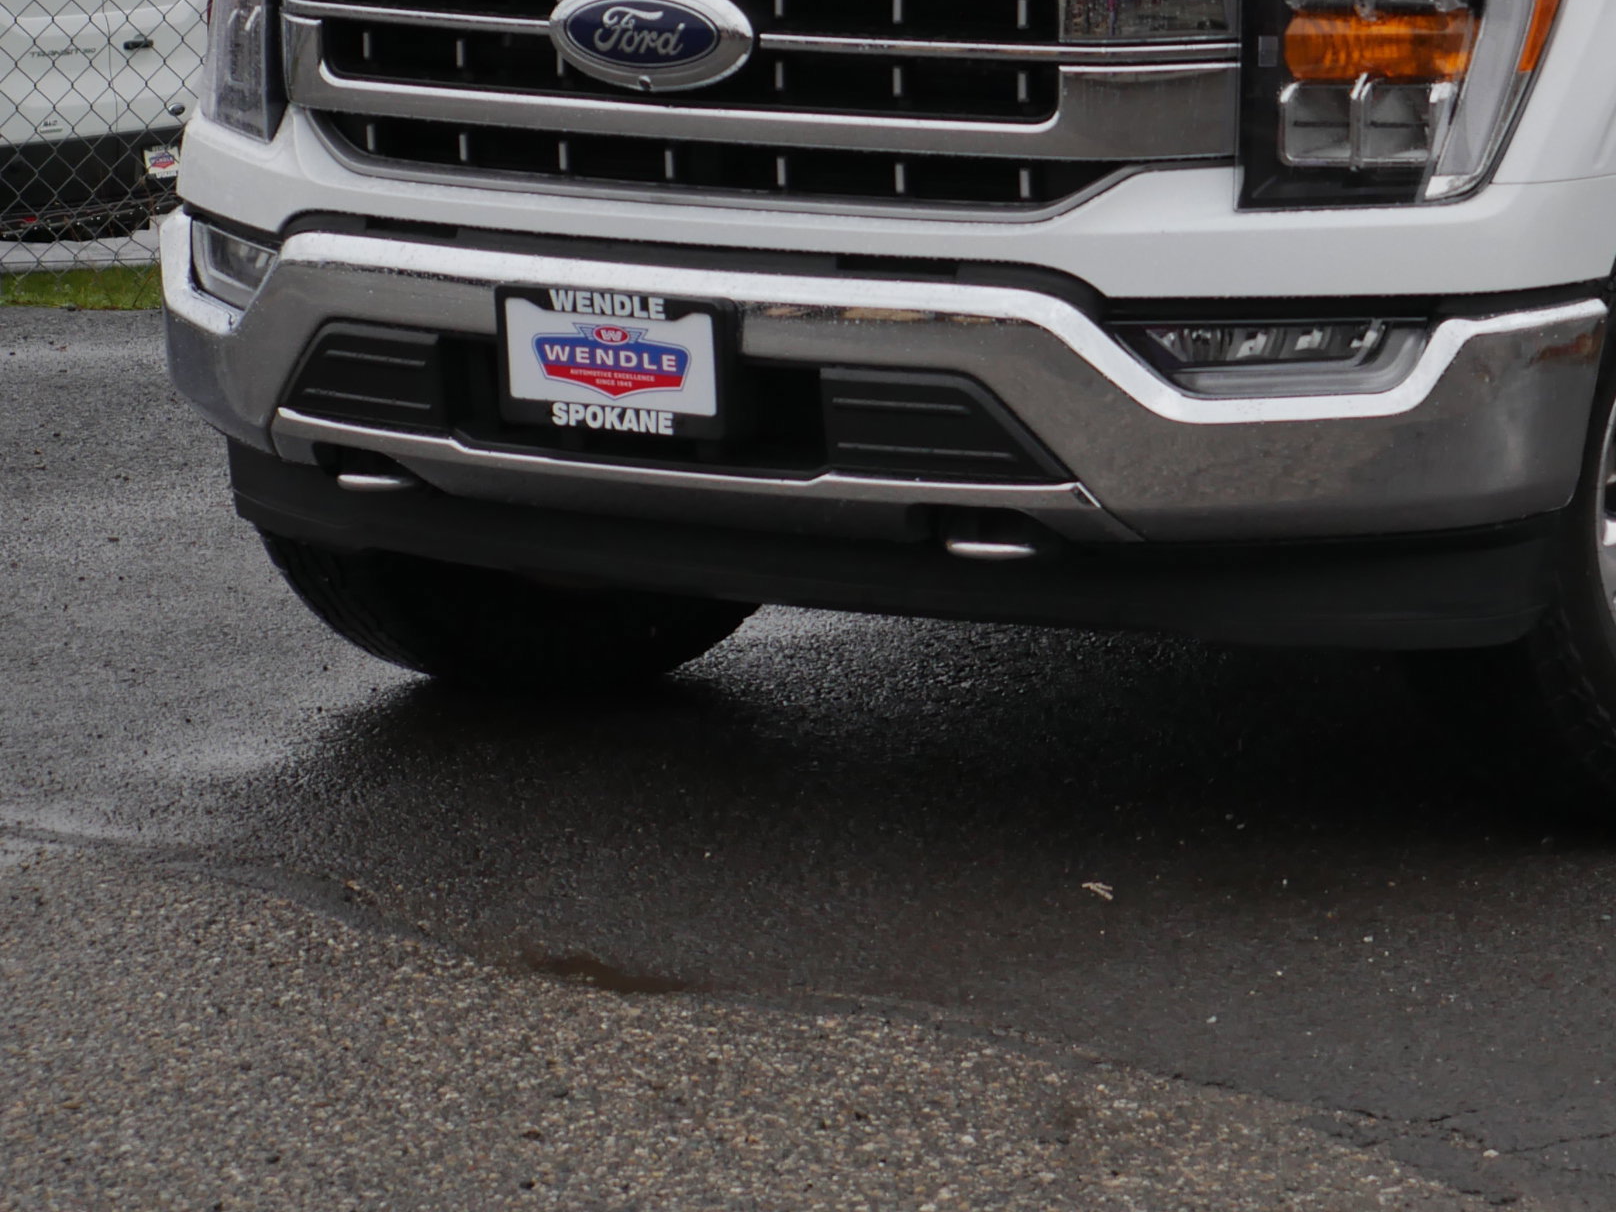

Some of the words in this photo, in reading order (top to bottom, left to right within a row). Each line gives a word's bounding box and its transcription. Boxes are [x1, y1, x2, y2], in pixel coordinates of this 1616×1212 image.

[594, 6, 686, 56] Ford
[550, 289, 666, 320] WENDLE
[544, 344, 677, 372] WENDLE
[552, 401, 674, 436] SPOKANE
